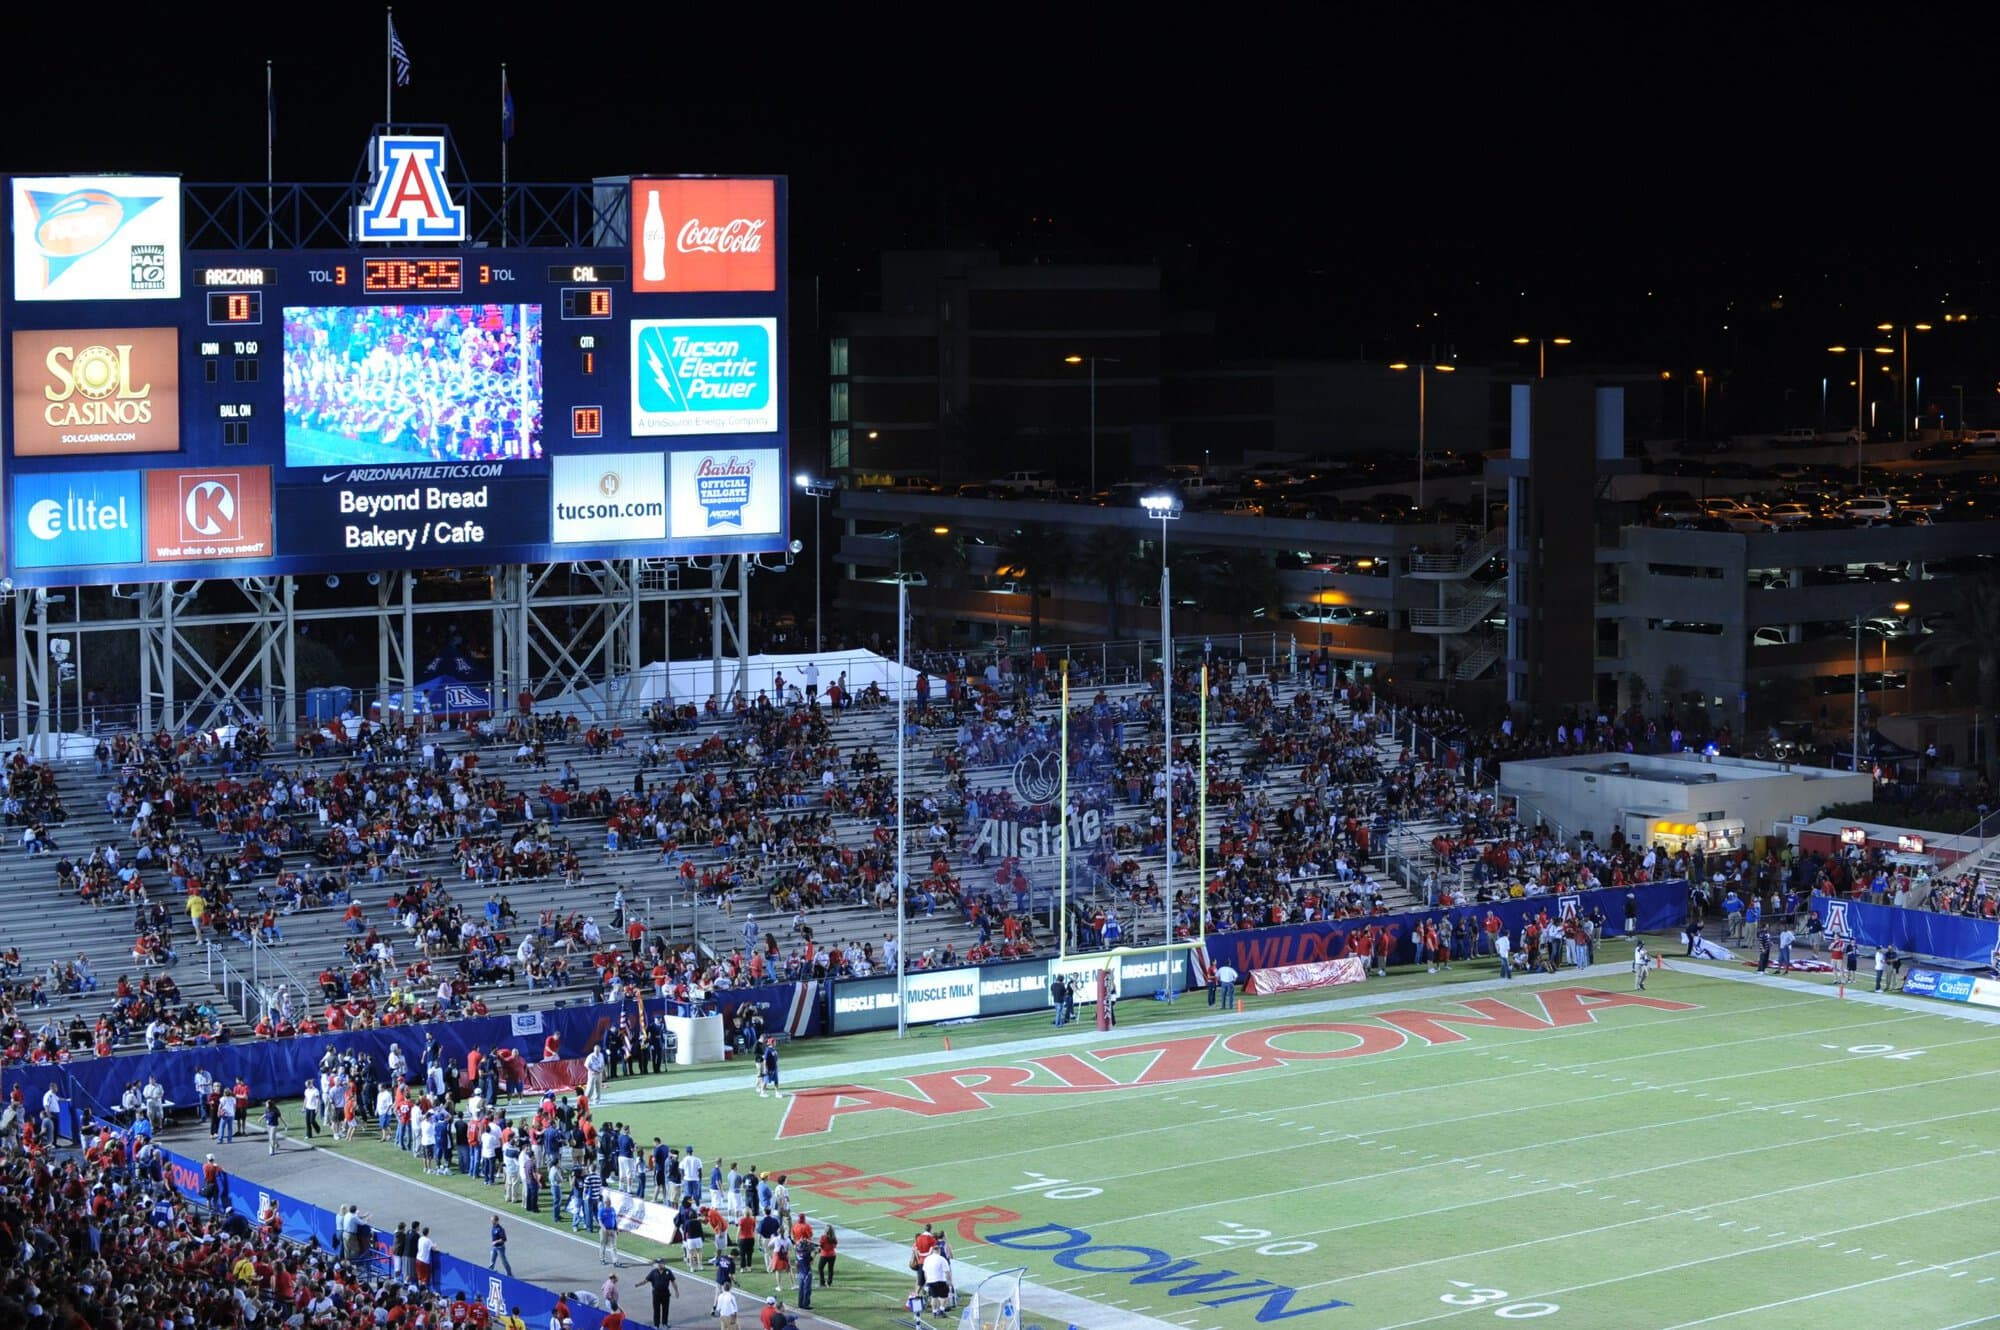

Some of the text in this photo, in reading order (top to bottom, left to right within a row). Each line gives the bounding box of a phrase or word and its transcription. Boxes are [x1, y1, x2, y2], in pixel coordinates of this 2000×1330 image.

[359, 135, 465, 241] A
[132, 256, 164, 267] PAC
[132, 267, 164, 281] 10
[205, 268, 263, 285] ARIZONA
[309, 270, 333, 282] TOL
[335, 266, 346, 285] 3
[366, 261, 459, 289] 20:25
[479, 265, 489, 283] 3
[493, 269, 515, 281] TOL
[573, 266, 598, 282] CAL
[229, 295, 248, 320] 0
[590, 291, 609, 315] 0
[202, 343, 219, 355] DWN
[234, 342, 258, 354] TO GO
[671, 336, 739, 358] Tucson
[44, 345, 150, 401] SOL
[679, 357, 758, 378] Electric
[687, 378, 756, 399] Power
[44, 401, 151, 426] CASINOS
[220, 405, 251, 417] BALL ON
[61, 433, 136, 443] SOLCASINOS.COM
[346, 464, 503, 482] ARIZONAATHLETICS.COM
[700, 488, 748, 497] TAILGATE
[701, 479, 748, 489] OFFICIAL
[340, 486, 488, 517] Beyond Bread
[556, 502, 663, 520] tucson.com
[28, 495, 129, 540] alltel
[345, 521, 485, 550] Bakery / Cafe
[157, 543, 265, 557] What else do you need?
[970, 809, 1101, 859] Allstate
[1824, 900, 1853, 942] A
[1121, 964, 1156, 979] MUSCLE
[1913, 974, 1934, 982] Game
[907, 983, 974, 1003] MUSCLE MILK
[980, 973, 1047, 994] MUSCLE MILK
[1907, 980, 1936, 991] Sponsor
[835, 994, 875, 1013] MUSCLE
[776, 986, 1704, 1139] ARIZONA
[767, 1160, 1022, 1245] BEAR
[1200, 1228, 1319, 1256] 20
[985, 1223, 1354, 1323] DOWN
[1439, 1288, 1561, 1319] 30
